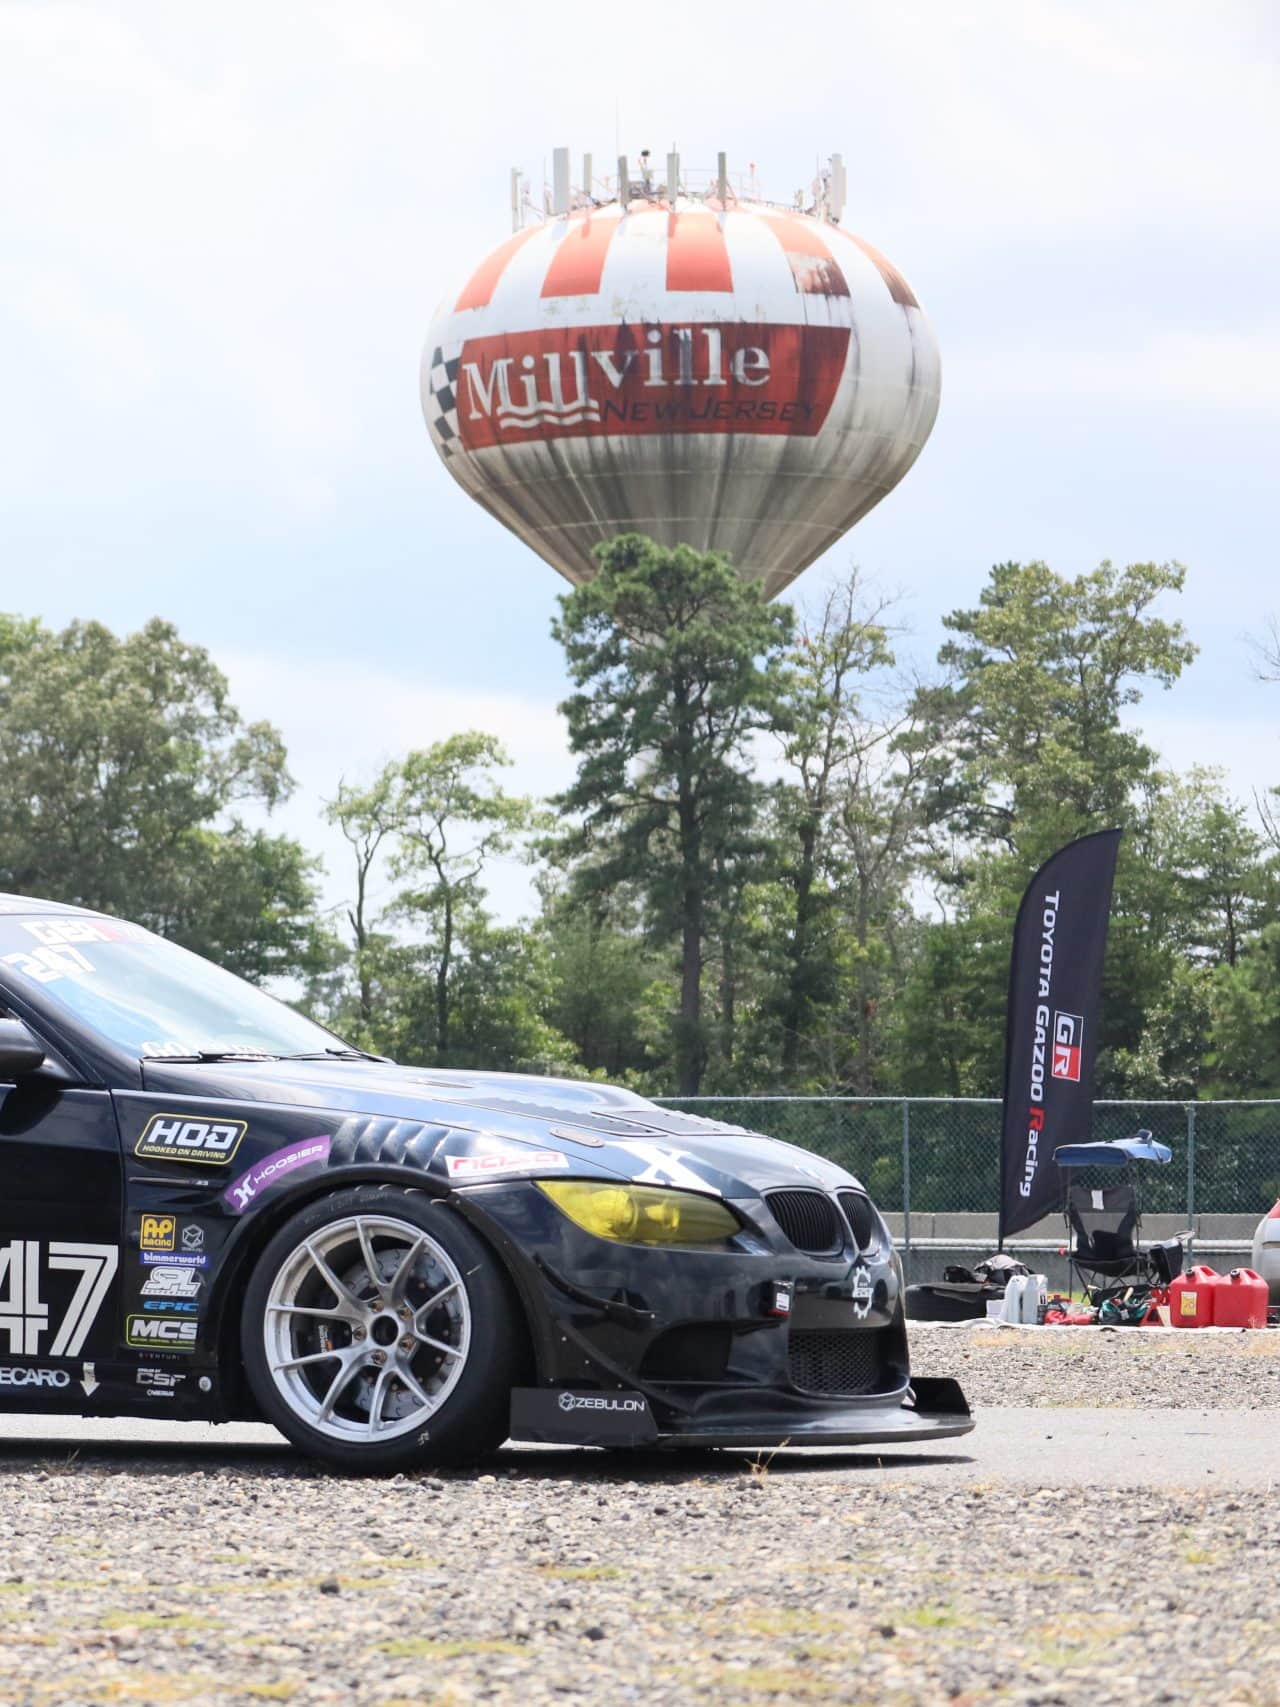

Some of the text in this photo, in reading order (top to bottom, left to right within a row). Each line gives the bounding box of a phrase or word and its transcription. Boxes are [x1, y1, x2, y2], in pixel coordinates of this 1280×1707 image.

[462, 327, 770, 420] Millville
[602, 397, 822, 422] NEW JERSEY
[1019, 890, 1060, 1197] TOYOTA GAZOO Racing
[1054, 1014, 1074, 1076] GR
[142, 1144, 226, 1159] HOOKED ON DRIVING
[254, 1144, 324, 1185] HOOSIER
[144, 1218, 173, 1239] AP
[143, 1252, 207, 1265] bimmerworld
[143, 1301, 199, 1312] EPIC
[131, 1319, 198, 1340] MCS
[575, 1397, 645, 1411] ZEBULON
